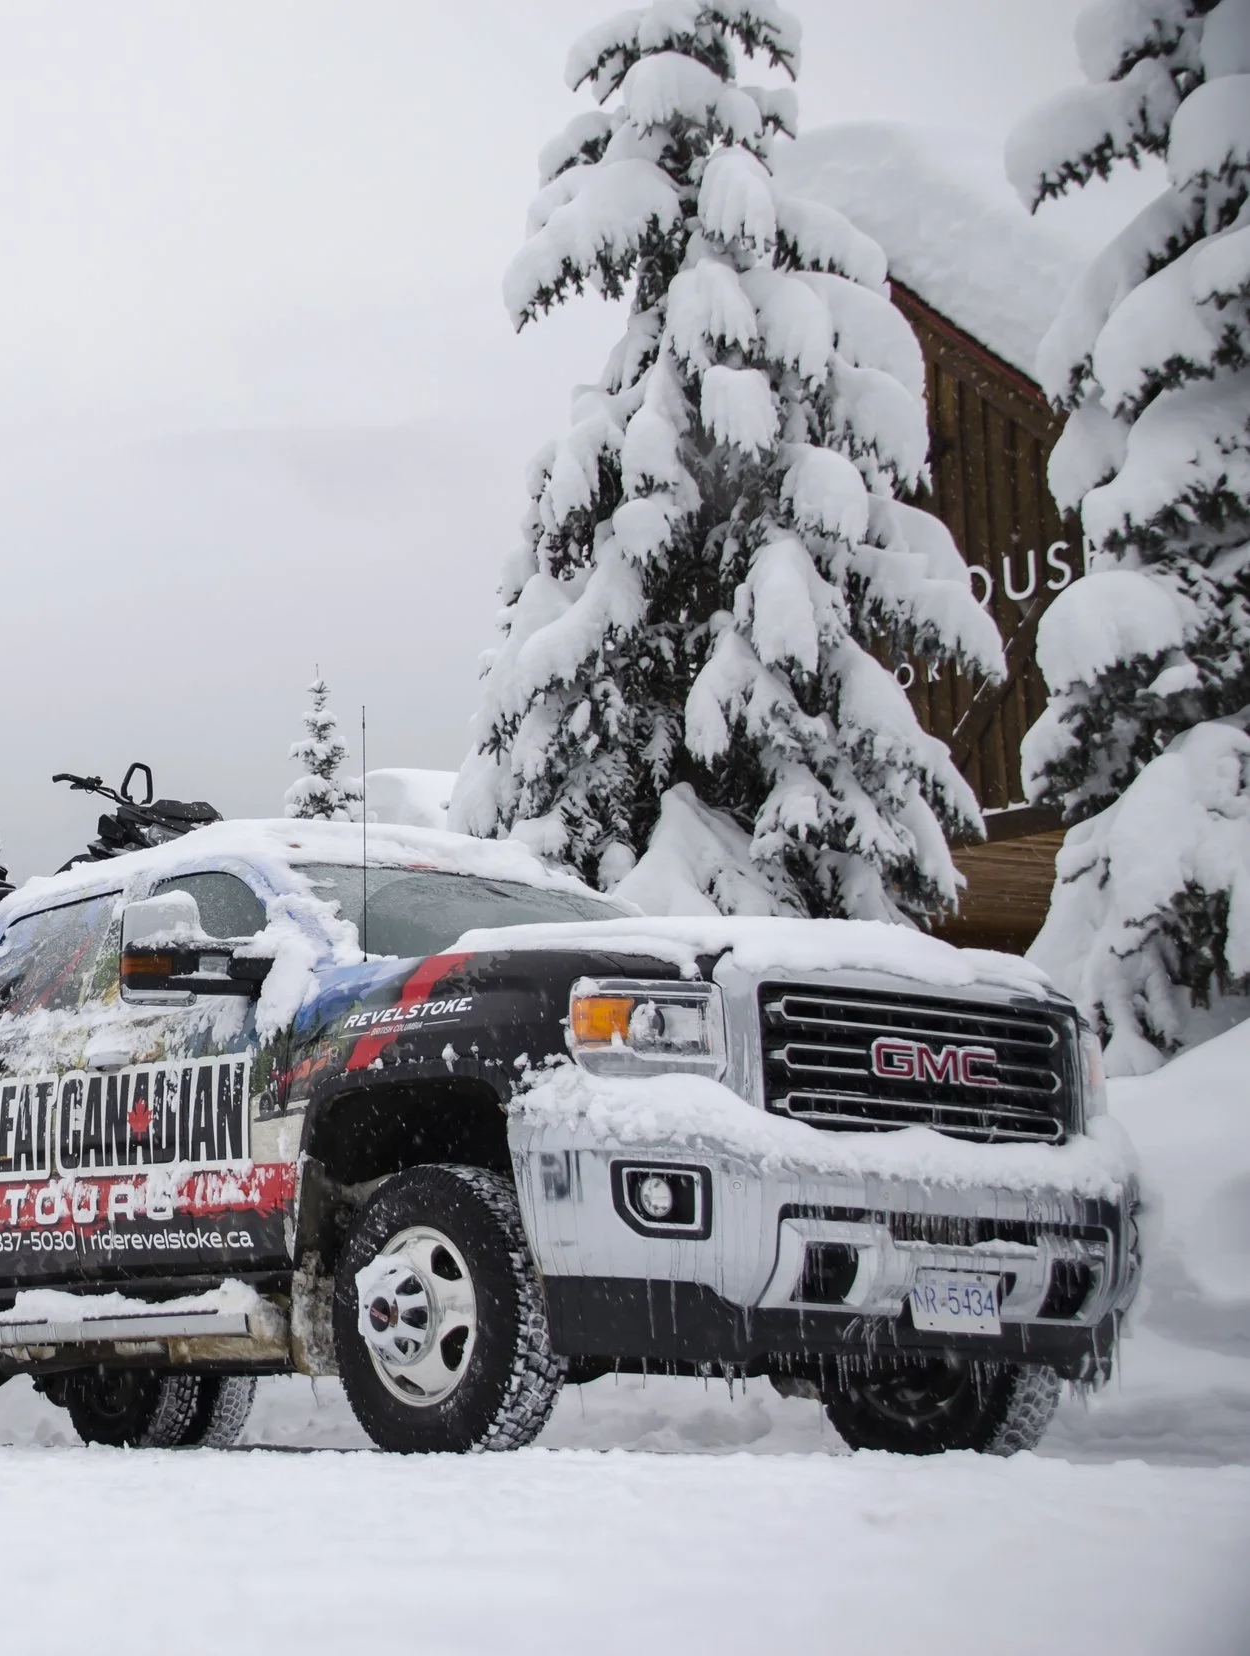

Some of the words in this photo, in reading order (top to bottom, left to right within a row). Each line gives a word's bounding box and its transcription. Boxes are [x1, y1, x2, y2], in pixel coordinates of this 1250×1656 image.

[967, 535, 1102, 607] OUS
[370, 1025, 393, 1036] BRITISH
[393, 1021, 424, 1034] COLUMBIA
[871, 1036, 999, 1087] GMC
[59, 1061, 246, 1170] CANADIAN
[90, 1228, 254, 1251] riderevelstoke.ca
